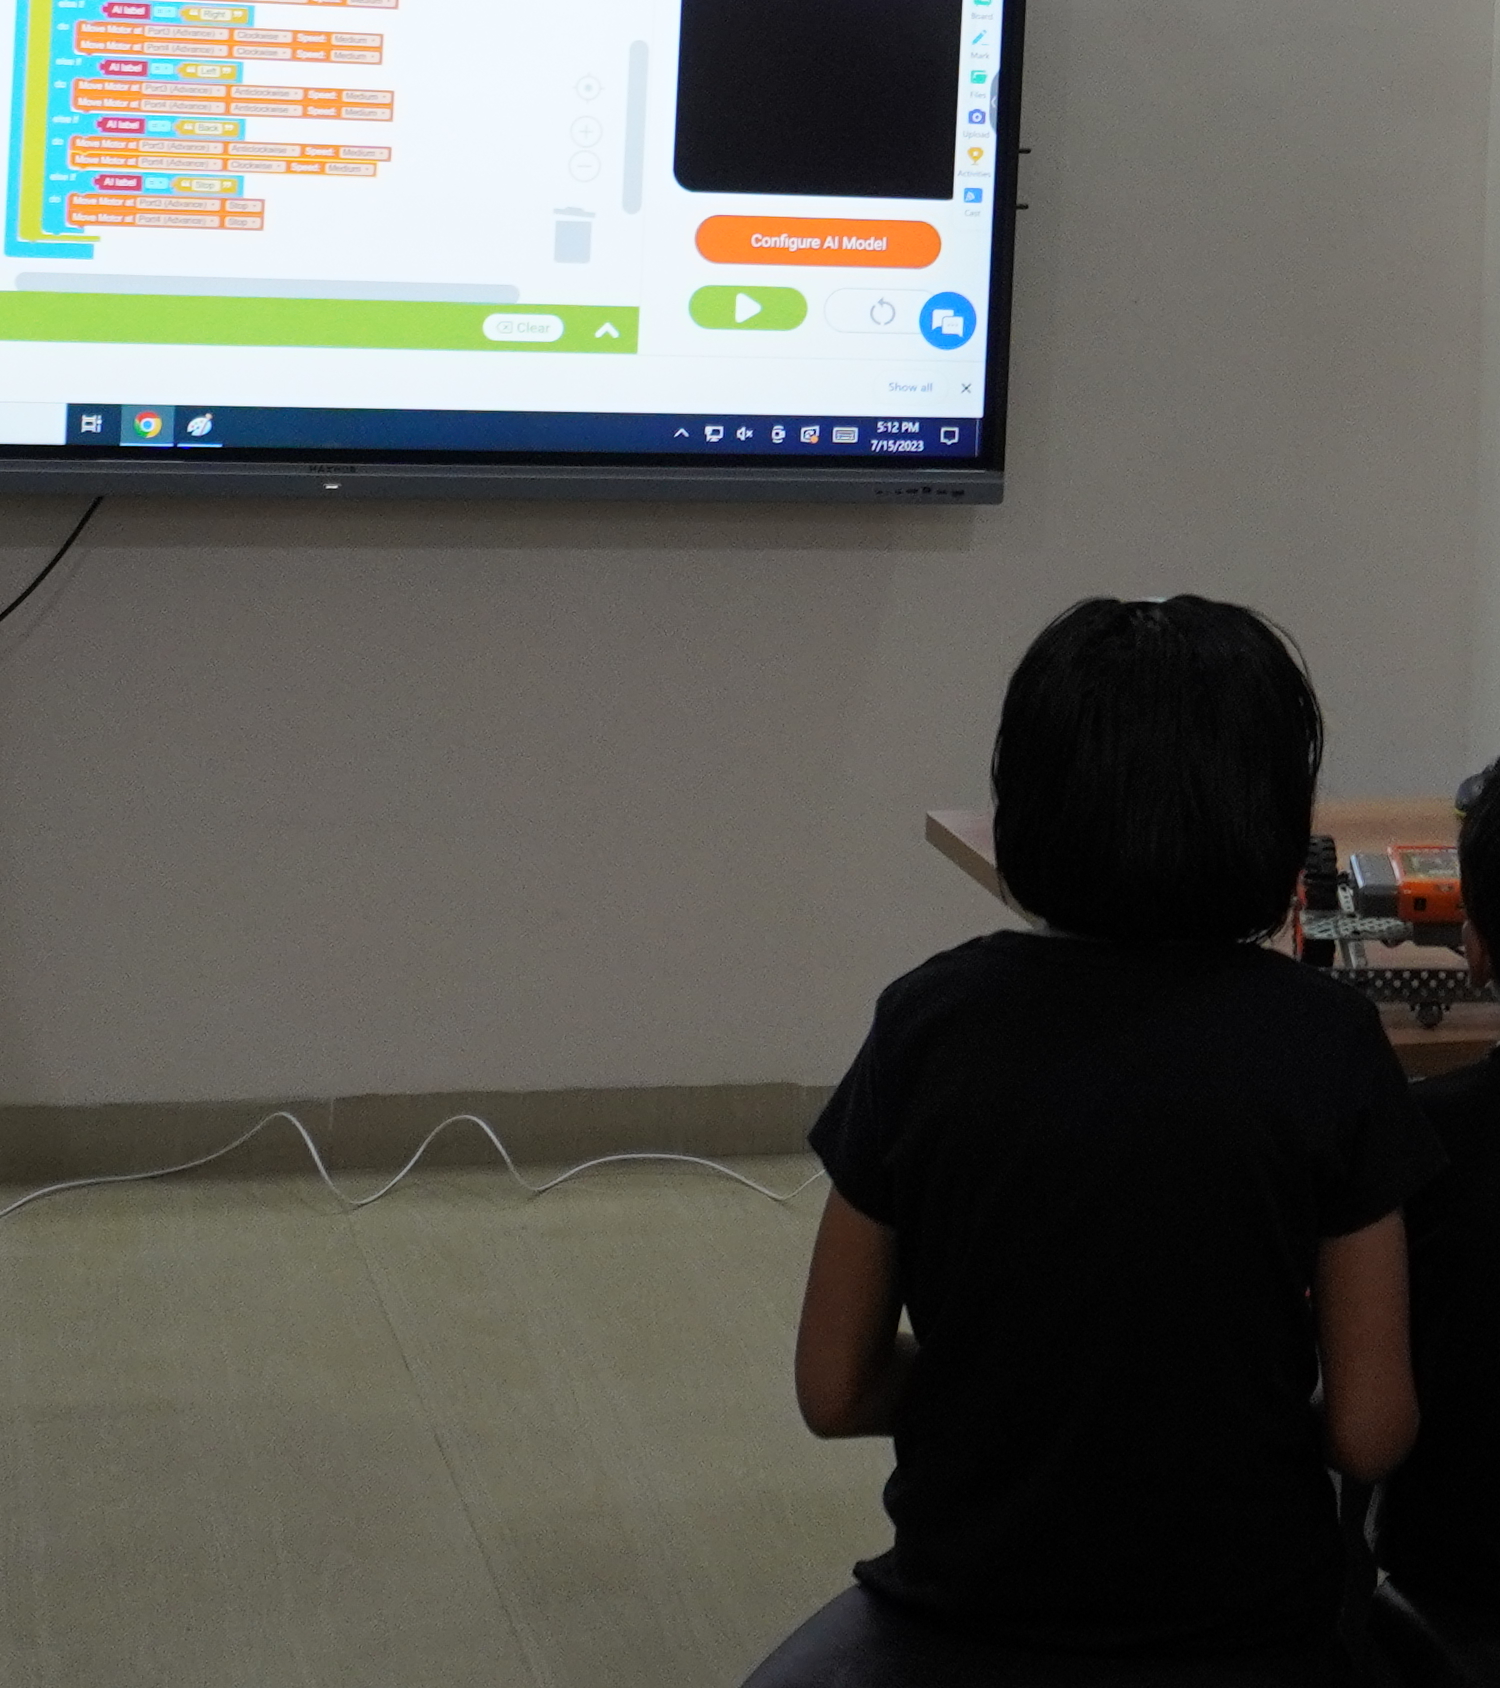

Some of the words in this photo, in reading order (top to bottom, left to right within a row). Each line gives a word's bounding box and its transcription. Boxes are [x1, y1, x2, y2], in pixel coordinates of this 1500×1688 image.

[750, 232, 821, 253] Configure
[822, 234, 839, 250] AI
[842, 234, 887, 251] Model
[516, 320, 550, 334] Clear
[888, 381, 912, 392] Show
[916, 381, 933, 393] all
[876, 420, 898, 434] 5:12
[900, 420, 919, 434] PM
[870, 438, 924, 453] 7/15/2023
